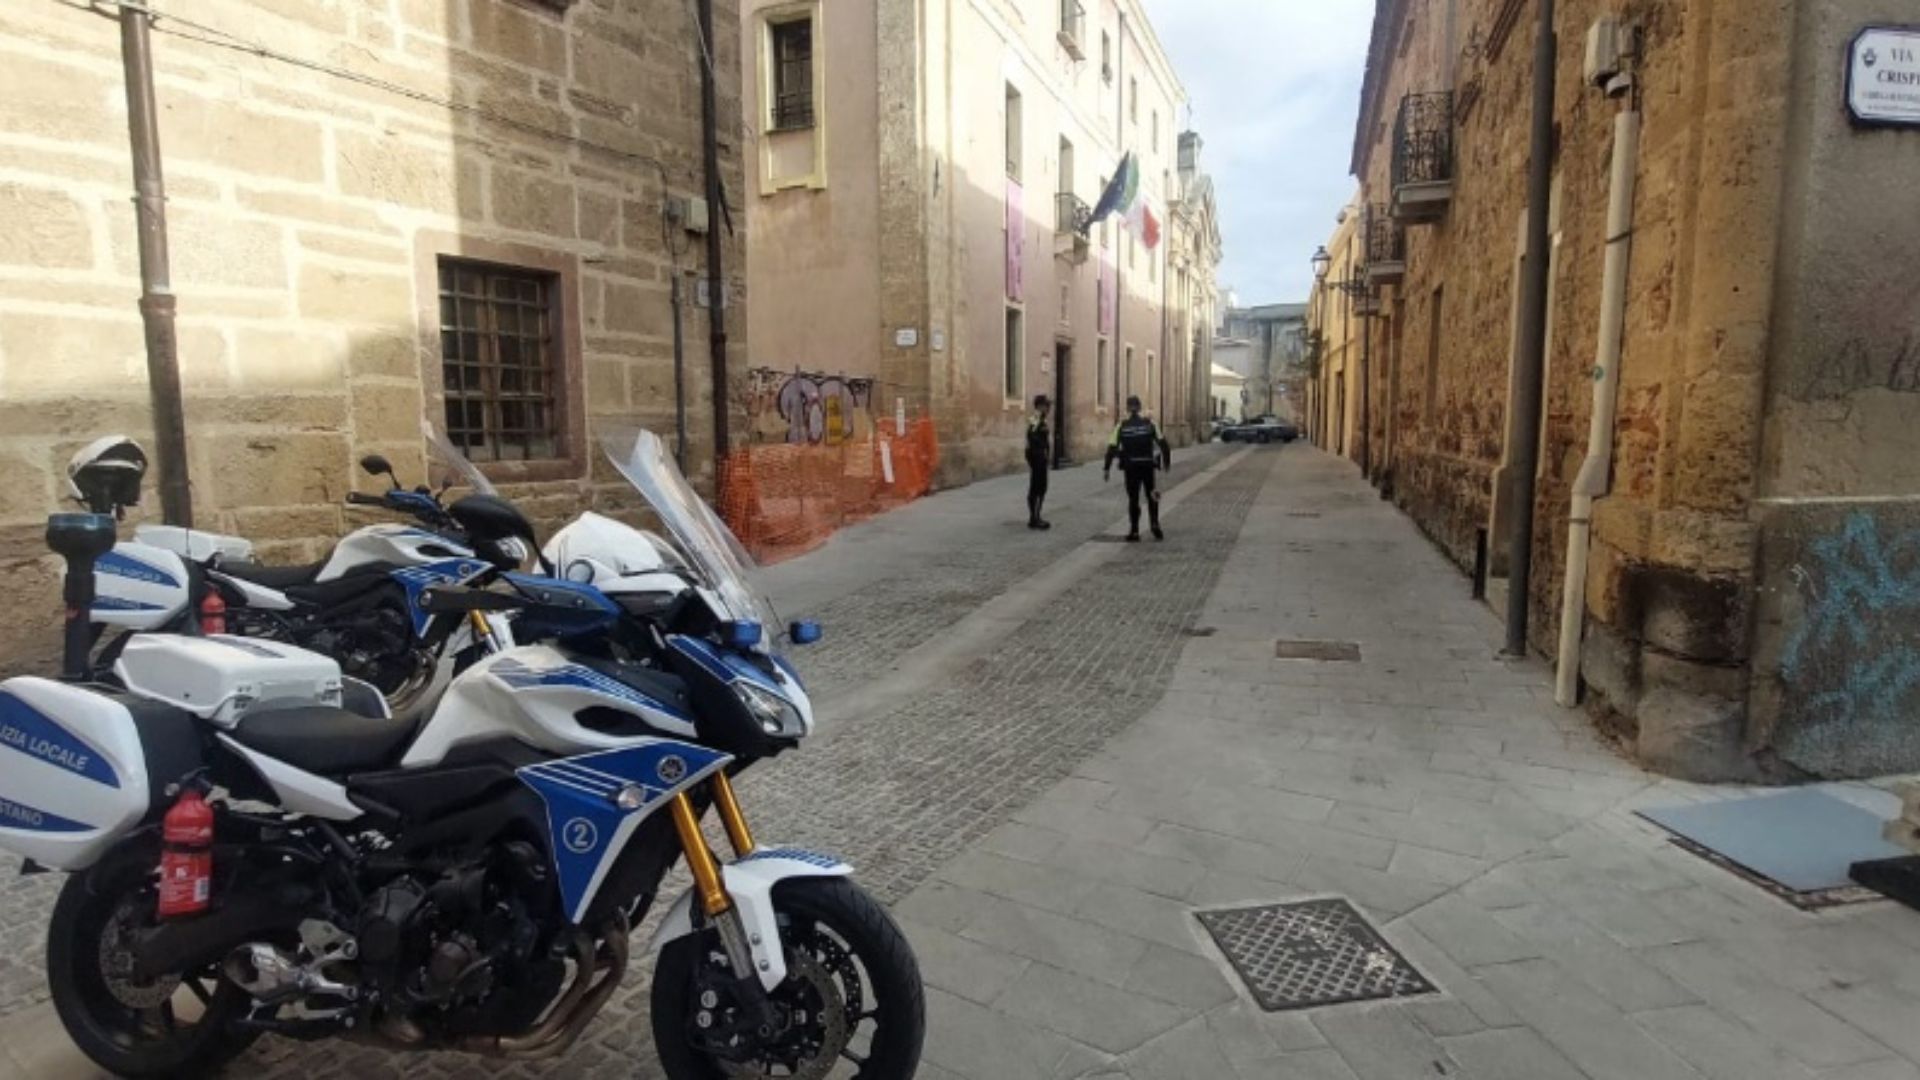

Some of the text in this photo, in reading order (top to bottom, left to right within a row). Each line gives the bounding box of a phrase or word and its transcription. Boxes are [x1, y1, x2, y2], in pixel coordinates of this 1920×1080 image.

[1891, 47, 1914, 63] VIA
[29, 737, 89, 770] LOCALE
[574, 824, 588, 846] 2
